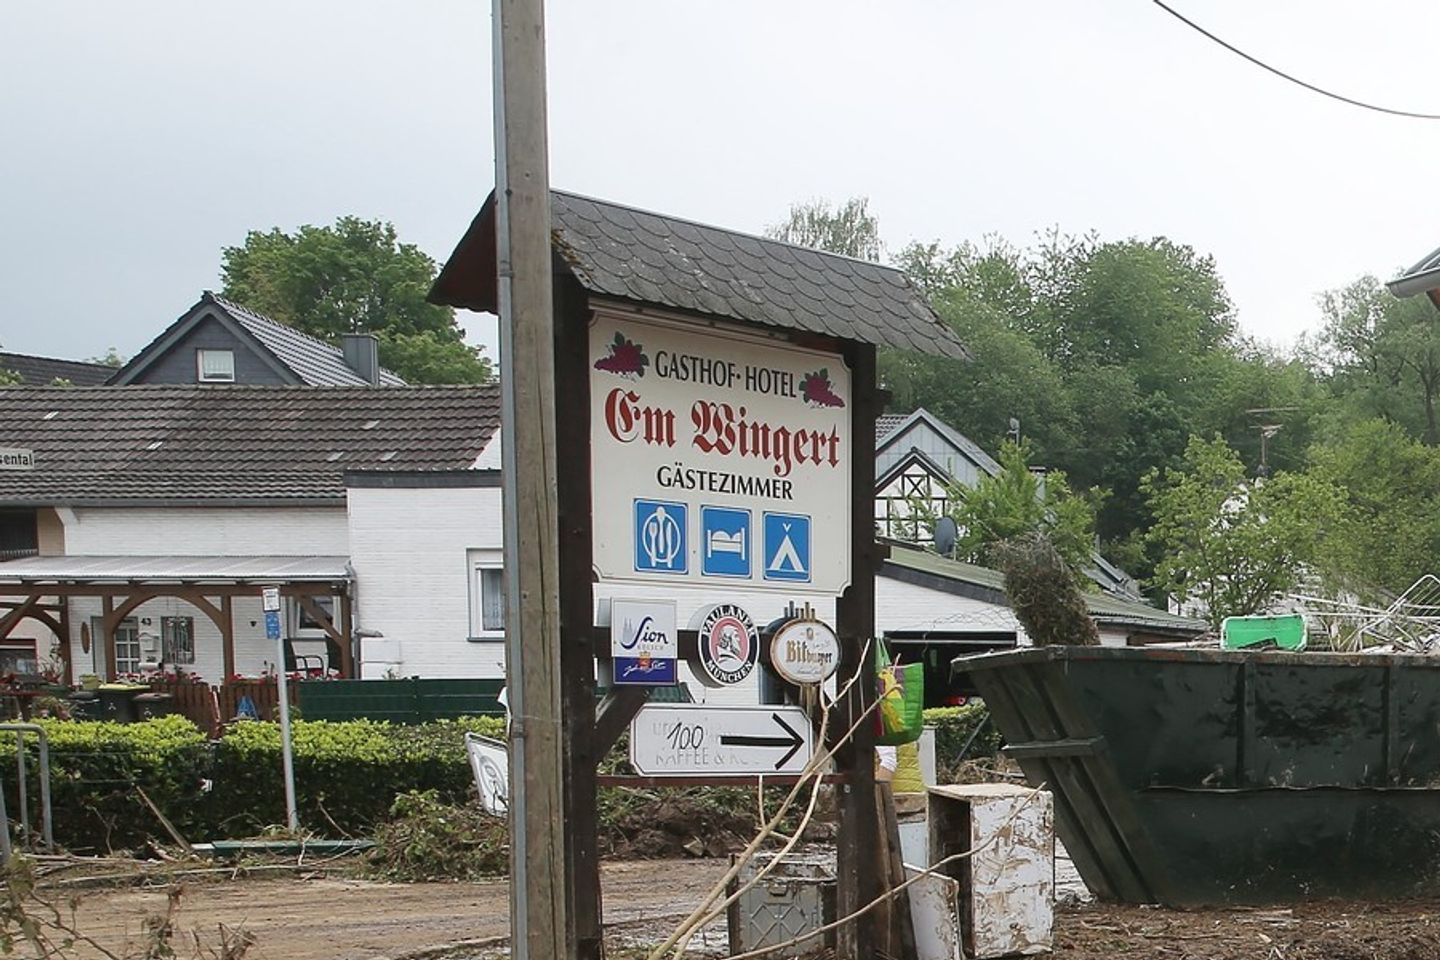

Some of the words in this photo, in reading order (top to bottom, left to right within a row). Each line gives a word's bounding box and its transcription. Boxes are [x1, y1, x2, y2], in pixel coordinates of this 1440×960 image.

[745, 366, 797, 398] HOTEL
[691, 399, 840, 478] Wingert
[657, 462, 793, 500] GÄSTEZIMMER
[620, 616, 669, 650] Sion
[702, 604, 756, 636] PAULANER
[785, 640, 833, 667] Bitburger
[667, 721, 704, 750] 100
